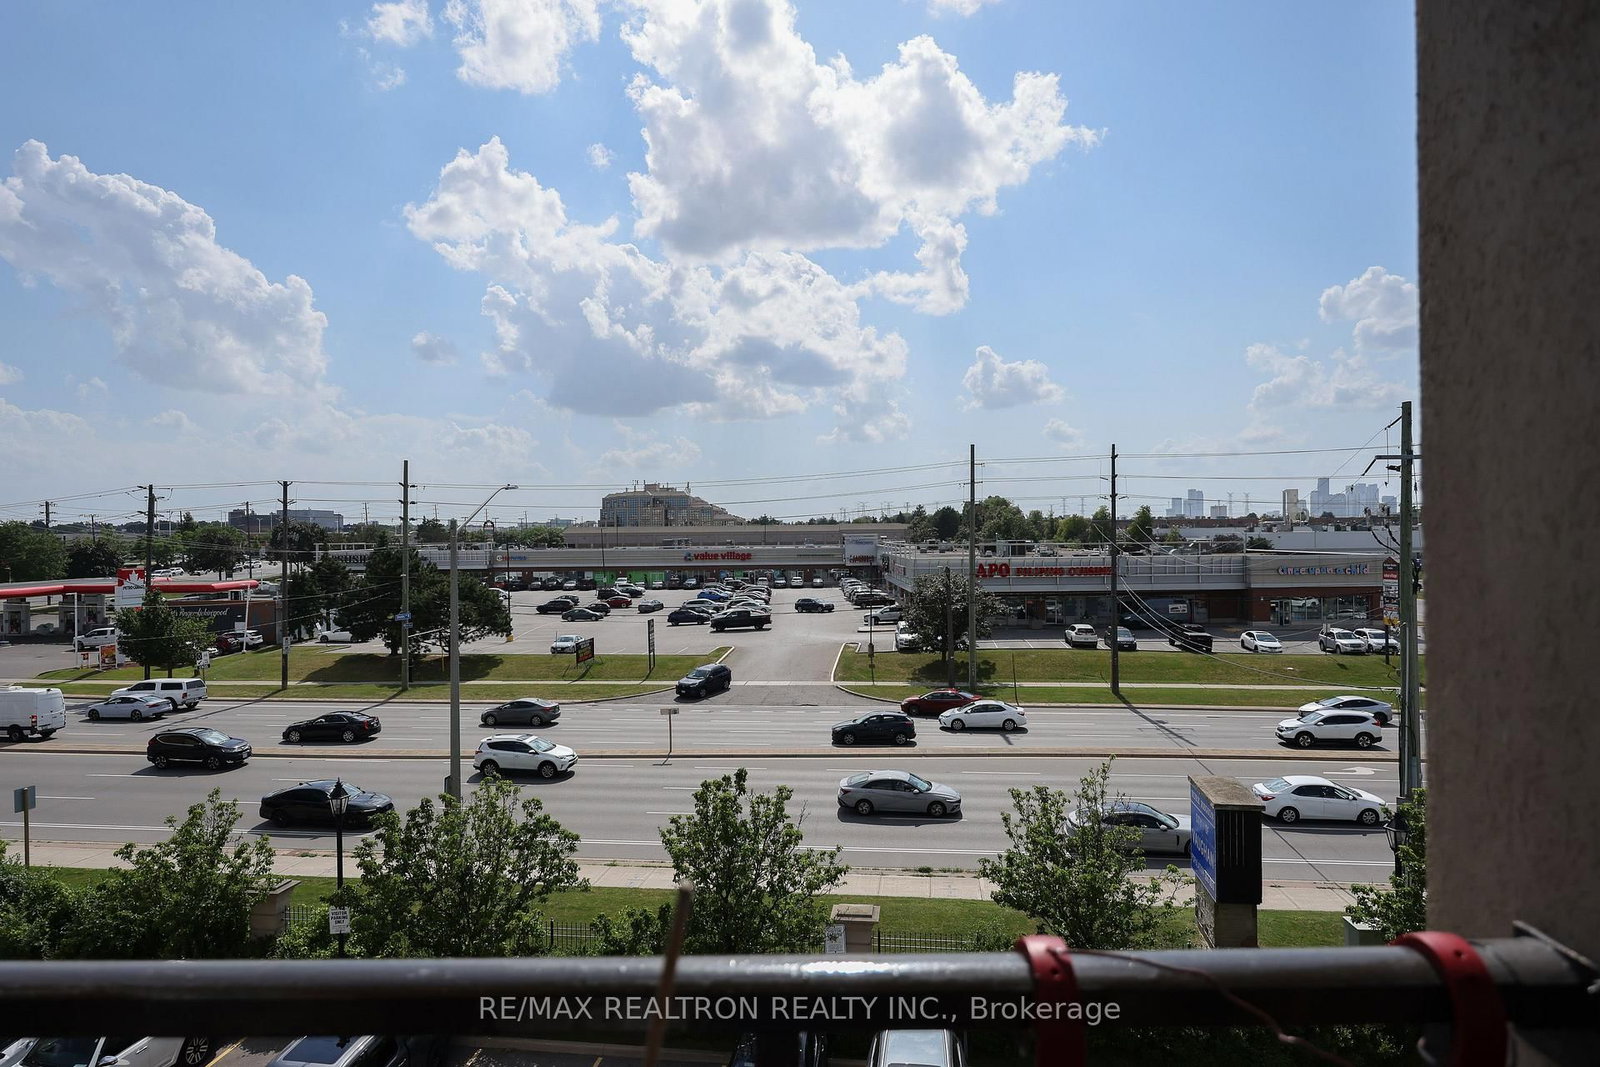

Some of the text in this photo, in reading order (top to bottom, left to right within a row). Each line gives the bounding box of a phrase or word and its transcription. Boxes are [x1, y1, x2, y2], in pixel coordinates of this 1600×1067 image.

[693, 551, 753, 561] value village
[975, 563, 1011, 578] APO
[1345, 563, 1370, 575] child
